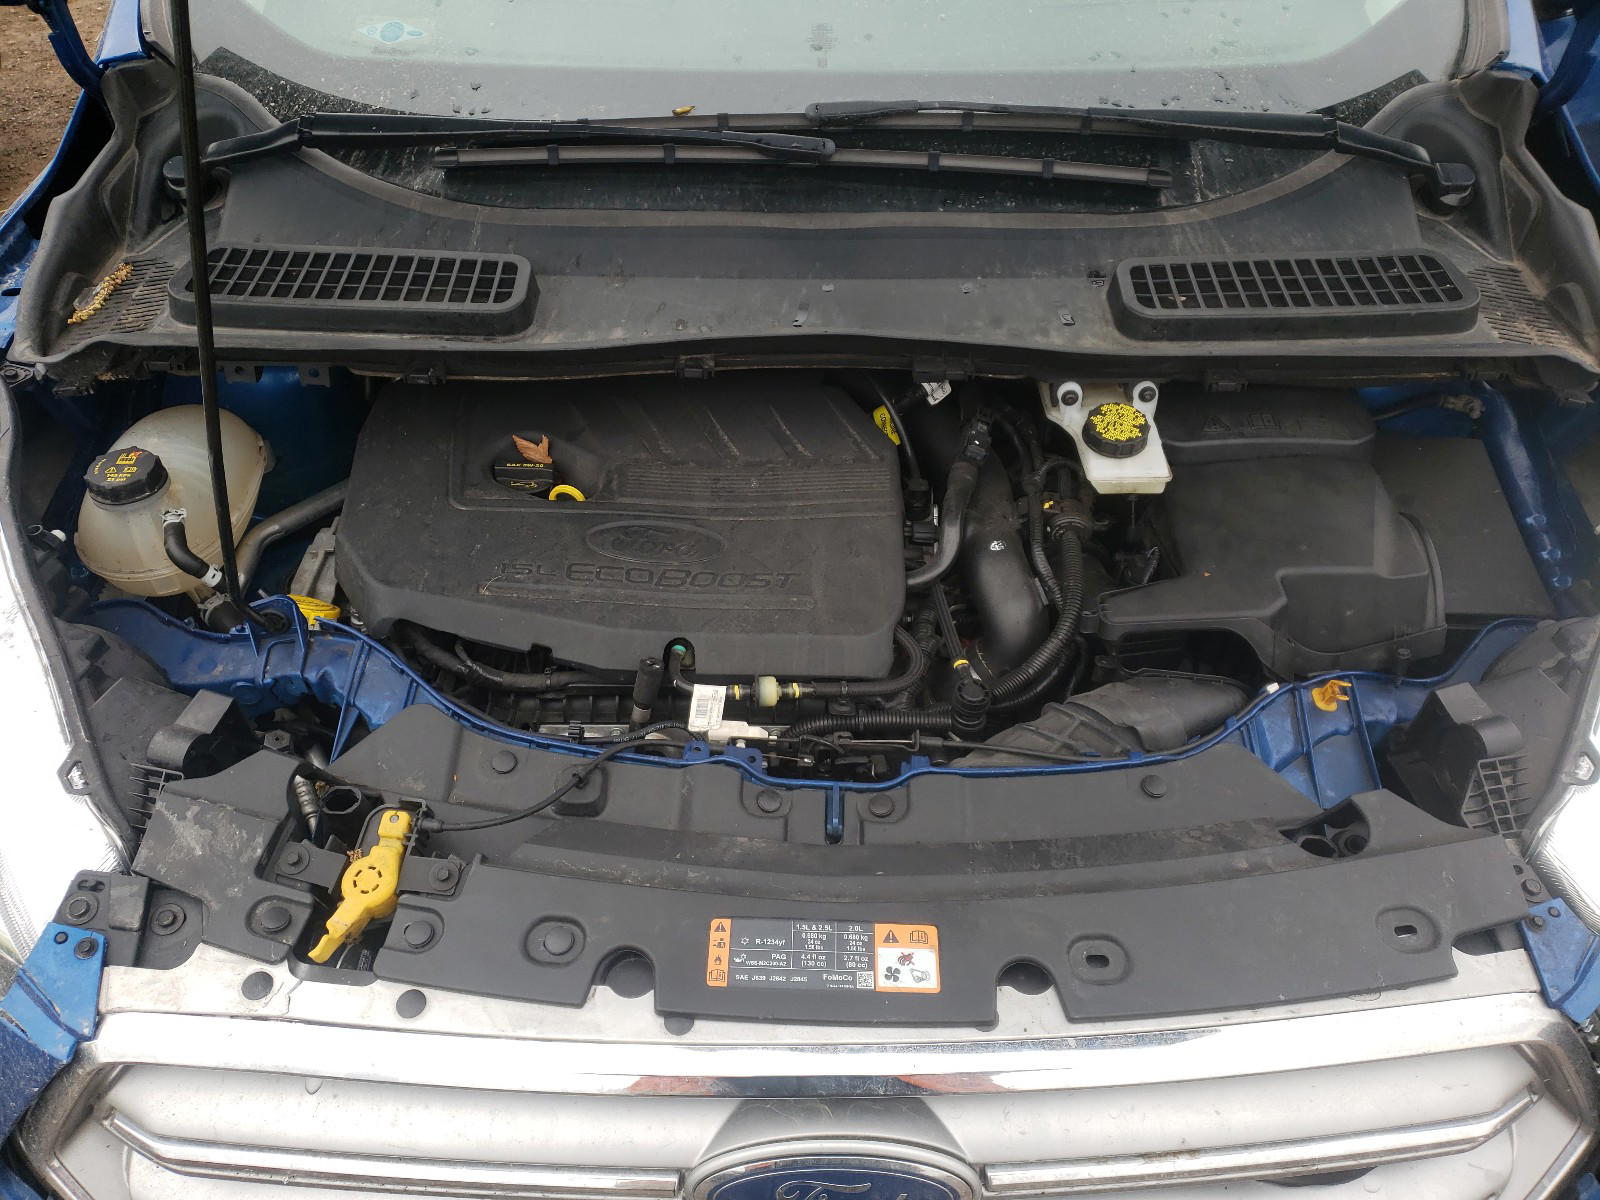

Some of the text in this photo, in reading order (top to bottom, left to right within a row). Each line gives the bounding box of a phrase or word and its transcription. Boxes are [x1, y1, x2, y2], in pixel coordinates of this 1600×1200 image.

[860, 934, 869, 942] kg
[755, 938, 786, 947] R-1234yf
[822, 973, 853, 981] FoMoCo
